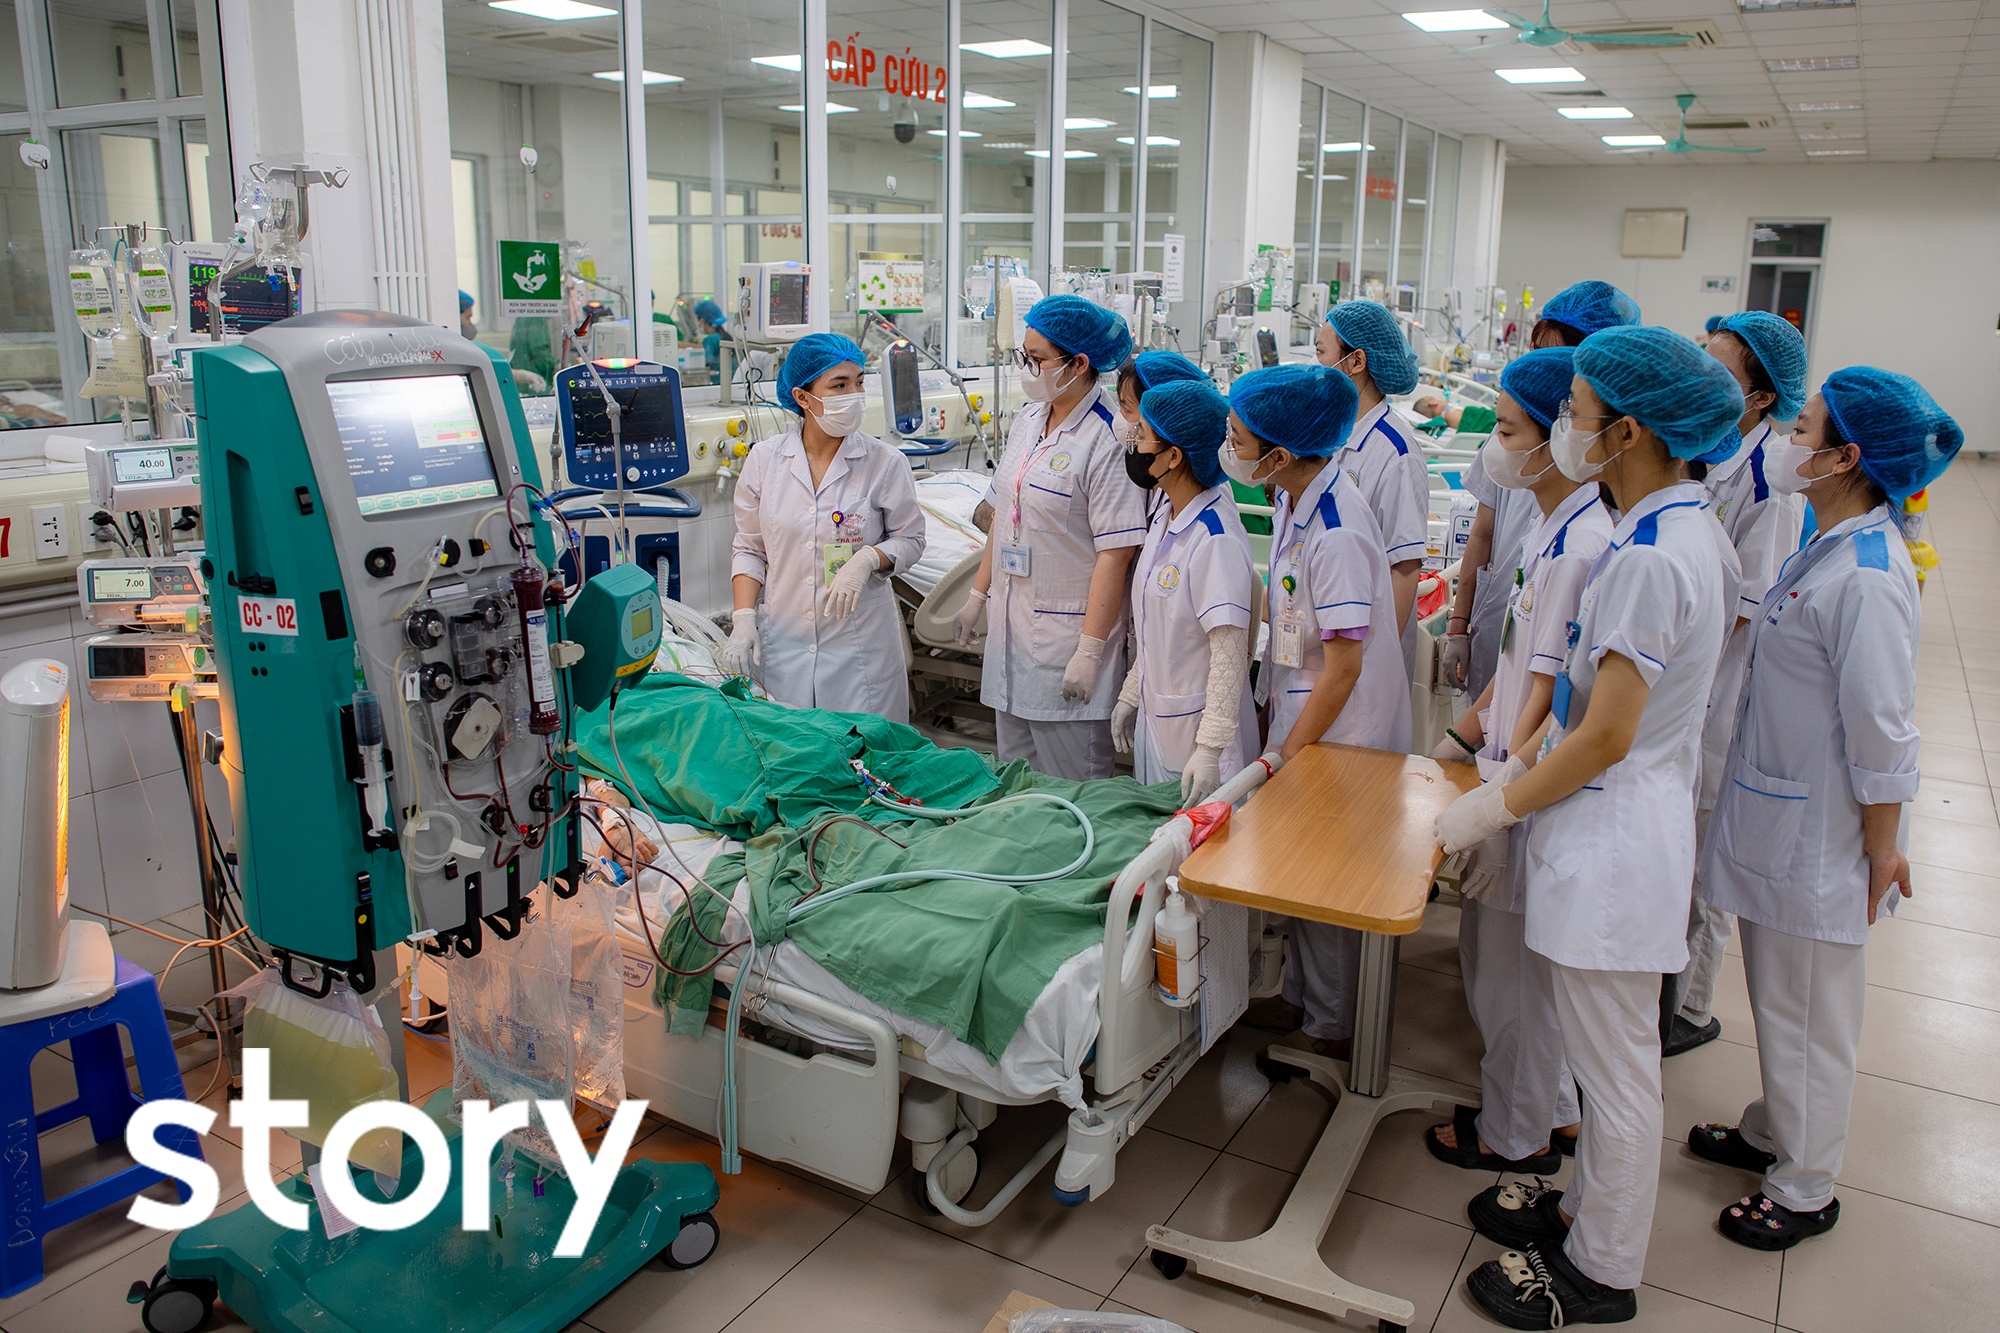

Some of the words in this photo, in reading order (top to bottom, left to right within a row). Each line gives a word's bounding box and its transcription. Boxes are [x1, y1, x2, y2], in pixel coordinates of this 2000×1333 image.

[827, 32, 876, 87] CẤP
[884, 47, 929, 100] CỨU
[935, 67, 947, 104] 2
[193, 266, 217, 279] 119
[940, 409, 946, 431] 5
[139, 459, 165, 469] 40.00
[0, 517, 12, 559] 7
[125, 579, 145, 587] 7.00
[243, 602, 262, 627] CC
[276, 604, 297, 629] 02
